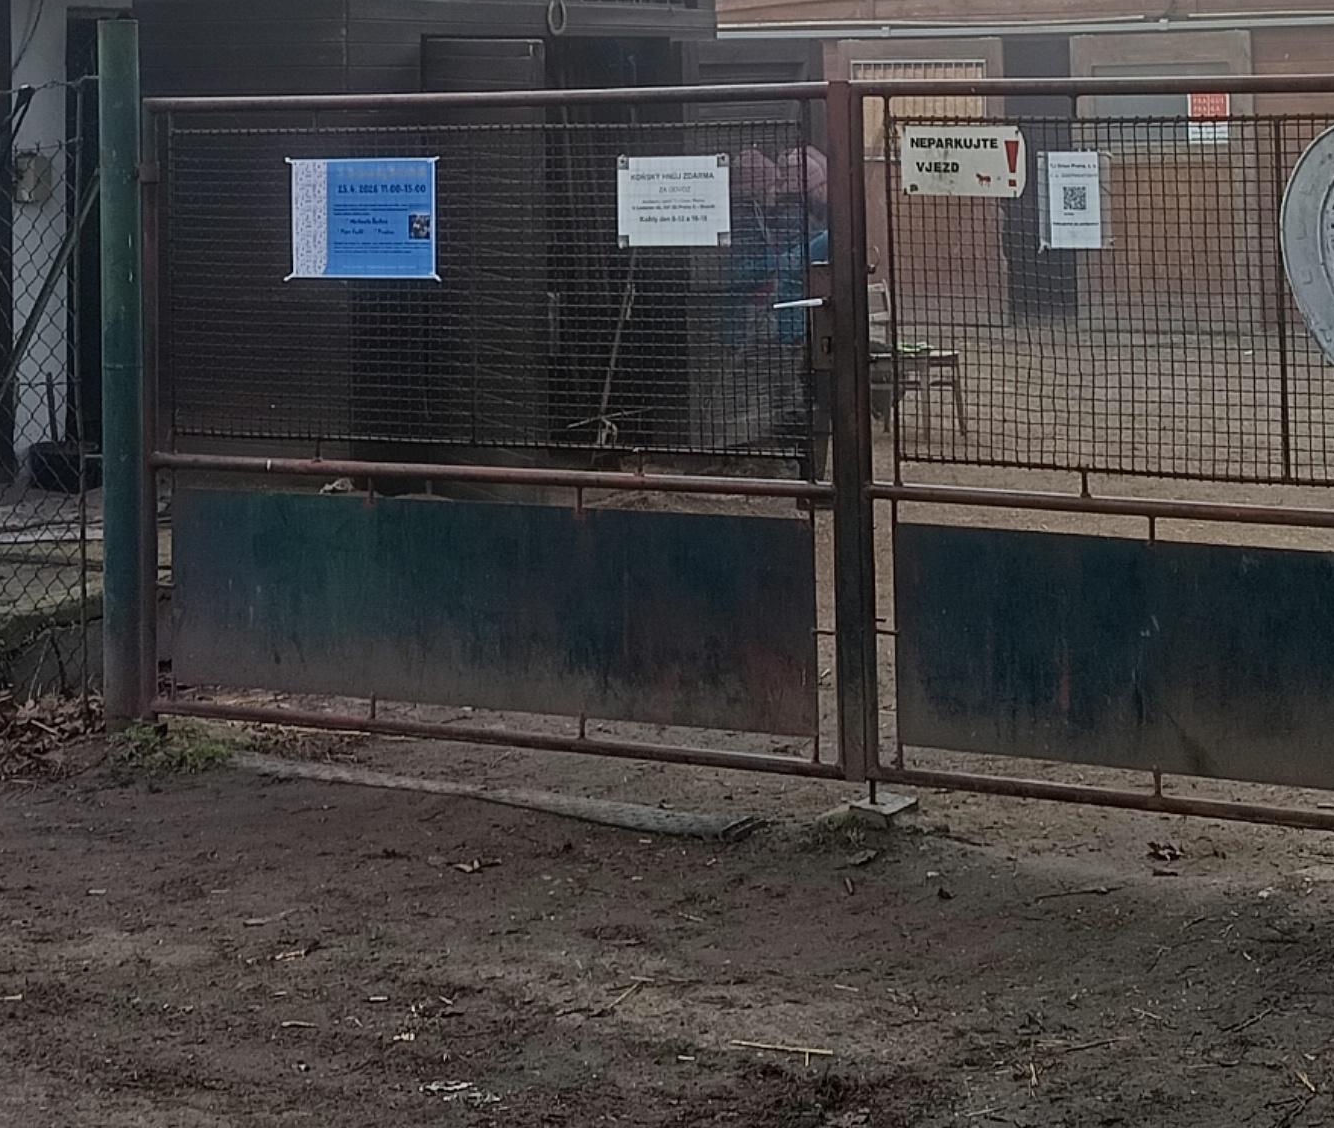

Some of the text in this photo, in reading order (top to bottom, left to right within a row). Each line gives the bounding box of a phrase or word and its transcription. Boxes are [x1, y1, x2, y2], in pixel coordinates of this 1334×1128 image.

[909, 137, 999, 150] NEPARKUJTE
[915, 161, 960, 173] VJEZD
[683, 171, 715, 181] ZDARMA
